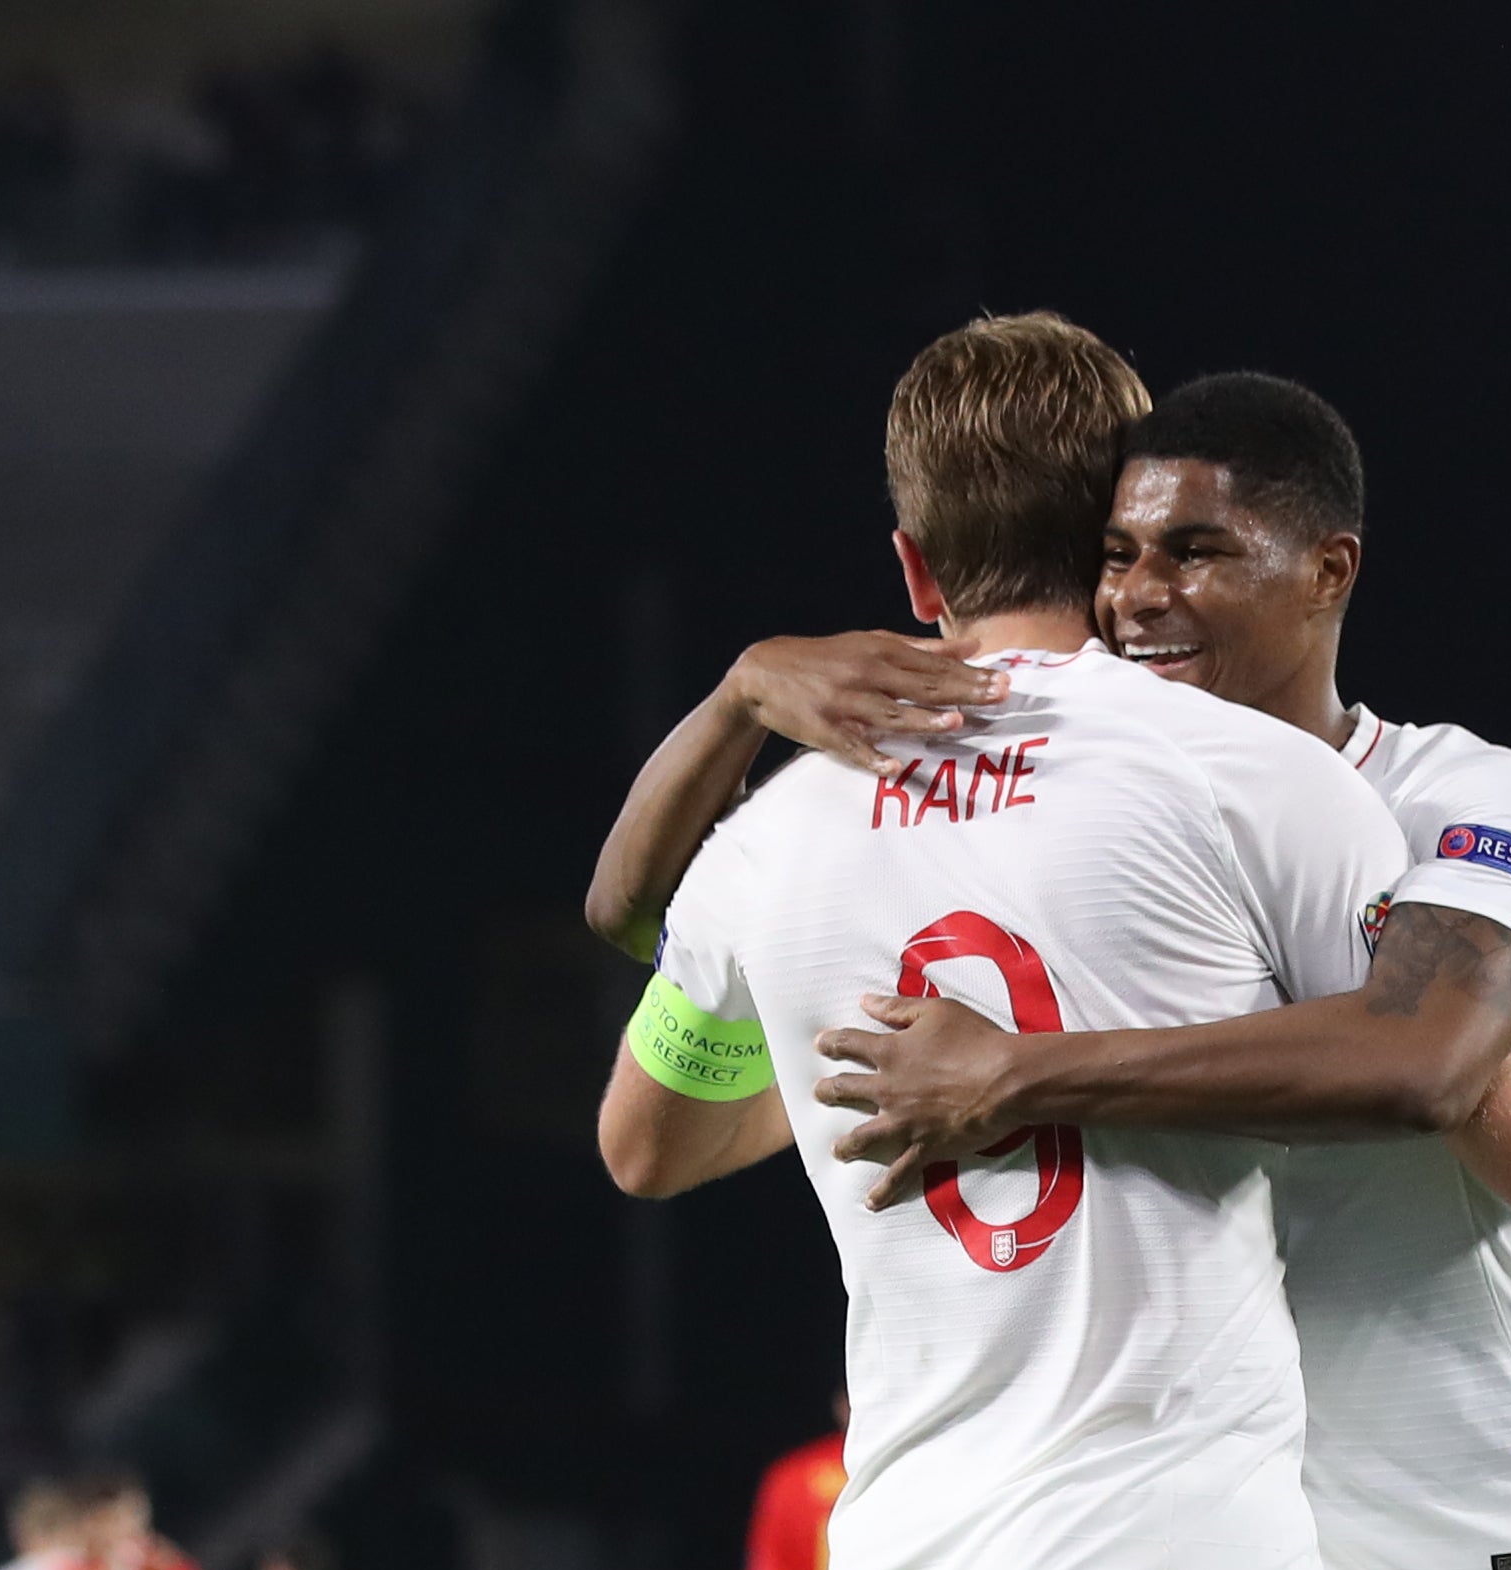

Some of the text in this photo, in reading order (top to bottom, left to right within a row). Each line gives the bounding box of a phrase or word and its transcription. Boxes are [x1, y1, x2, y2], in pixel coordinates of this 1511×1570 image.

[871, 736, 1049, 830] KANE
[658, 1005, 678, 1033] TO
[680, 1027, 764, 1059] RACISM
[652, 1036, 742, 1083] RESPECT
